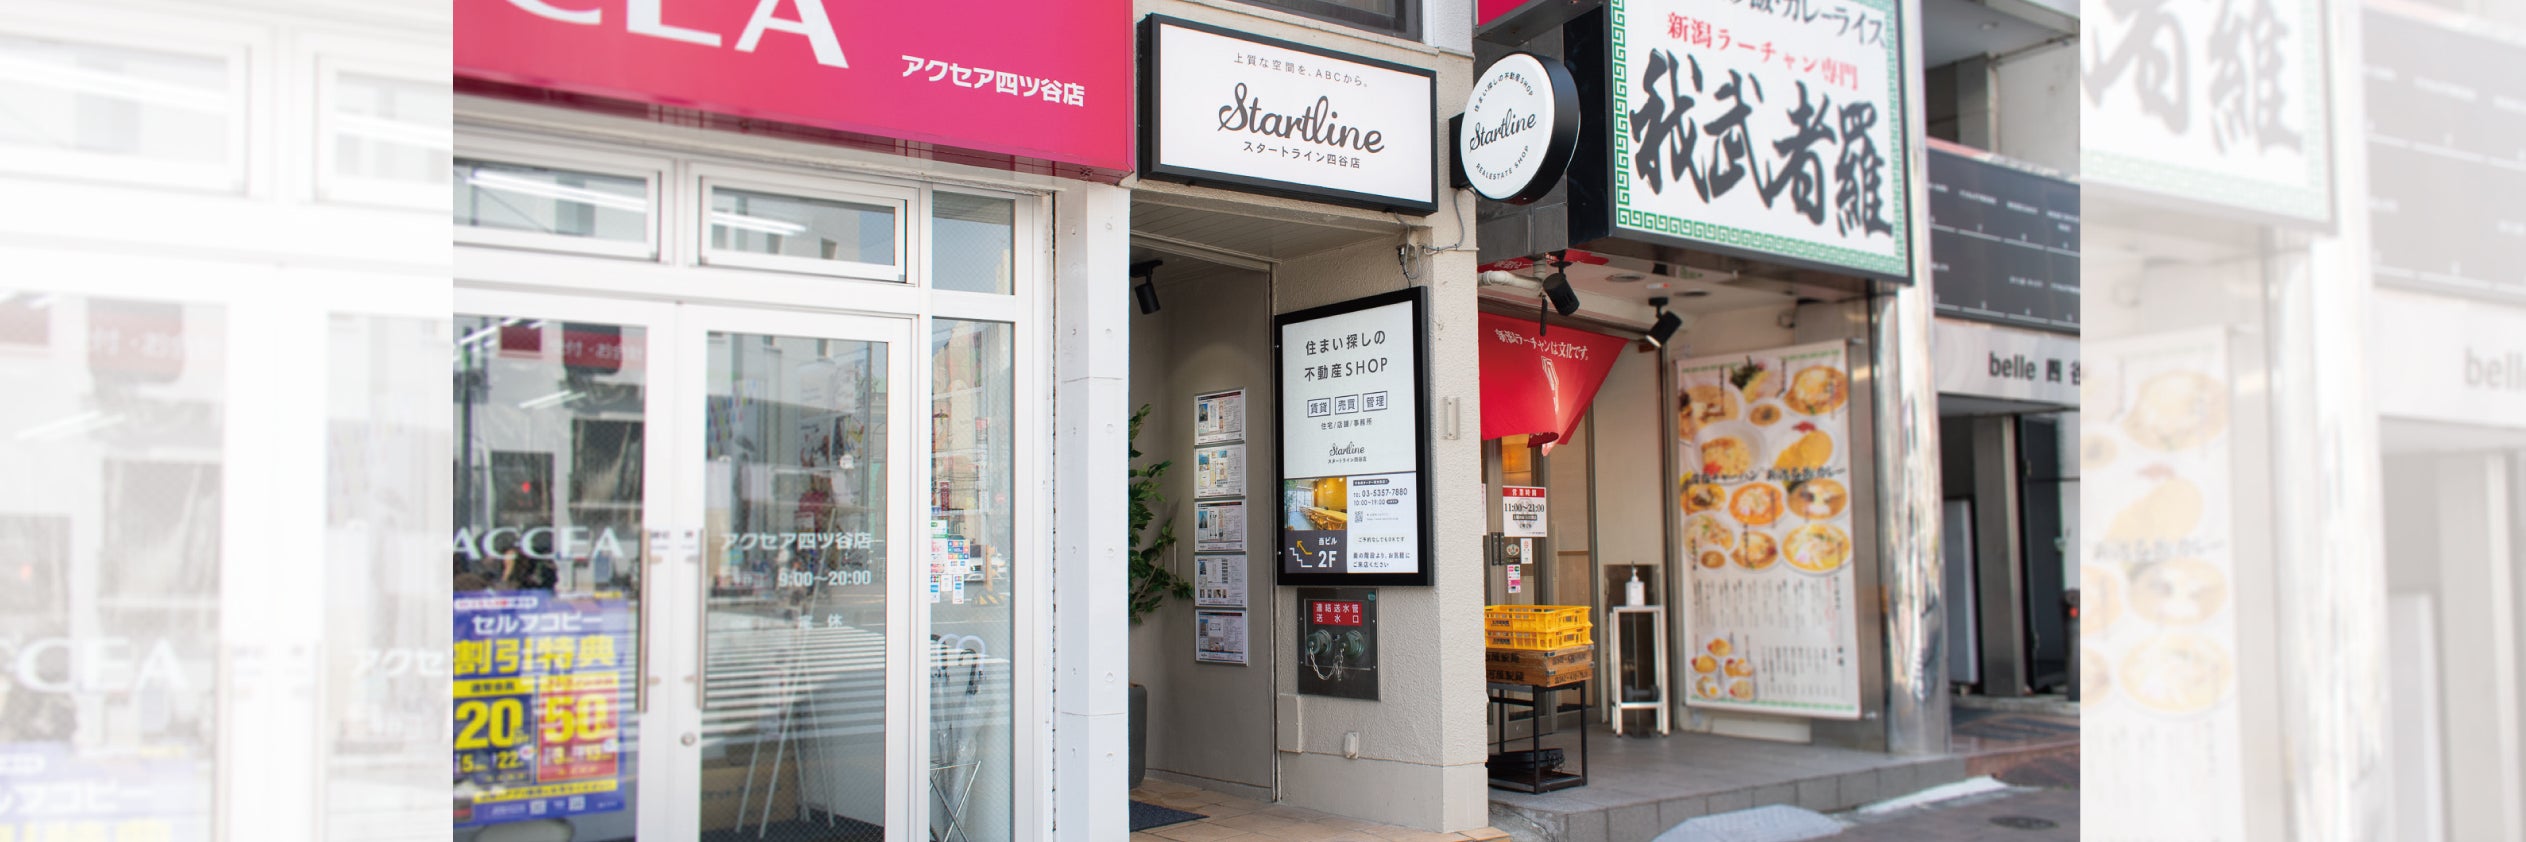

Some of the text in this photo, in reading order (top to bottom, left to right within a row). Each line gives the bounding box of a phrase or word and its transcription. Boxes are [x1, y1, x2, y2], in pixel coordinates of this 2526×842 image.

[1667, 12, 1858, 91] 新潟ラーチャン専門
[901, 54, 1085, 107] アクセア四ツ谷店
[1233, 52, 1368, 88] 上質な空間を、ABCから。
[1217, 82, 1385, 154] Startline
[1469, 108, 1537, 152] Startline
[1243, 141, 1361, 169] スタートライン四谷店
[1514, 144, 1530, 169] SHOP
[1629, 48, 1893, 238] 我武者羅
[1305, 330, 1386, 356] 住まい探しの
[1304, 357, 1388, 382] 不動産SHOP
[1988, 351, 2036, 381] belle
[1310, 396, 1385, 414] 賃貸 売買 管理
[1329, 441, 1365, 456] Startline
[719, 531, 872, 551] アクセア四ツ谷店
[1318, 550, 1337, 568] 2F
[1316, 603, 1359, 614] 連結送水管
[1316, 614, 1359, 624] 送水口
[472, 612, 603, 635] セルフコピー
[453, 634, 616, 676] 割引特典
[454, 693, 609, 750] 20 50
